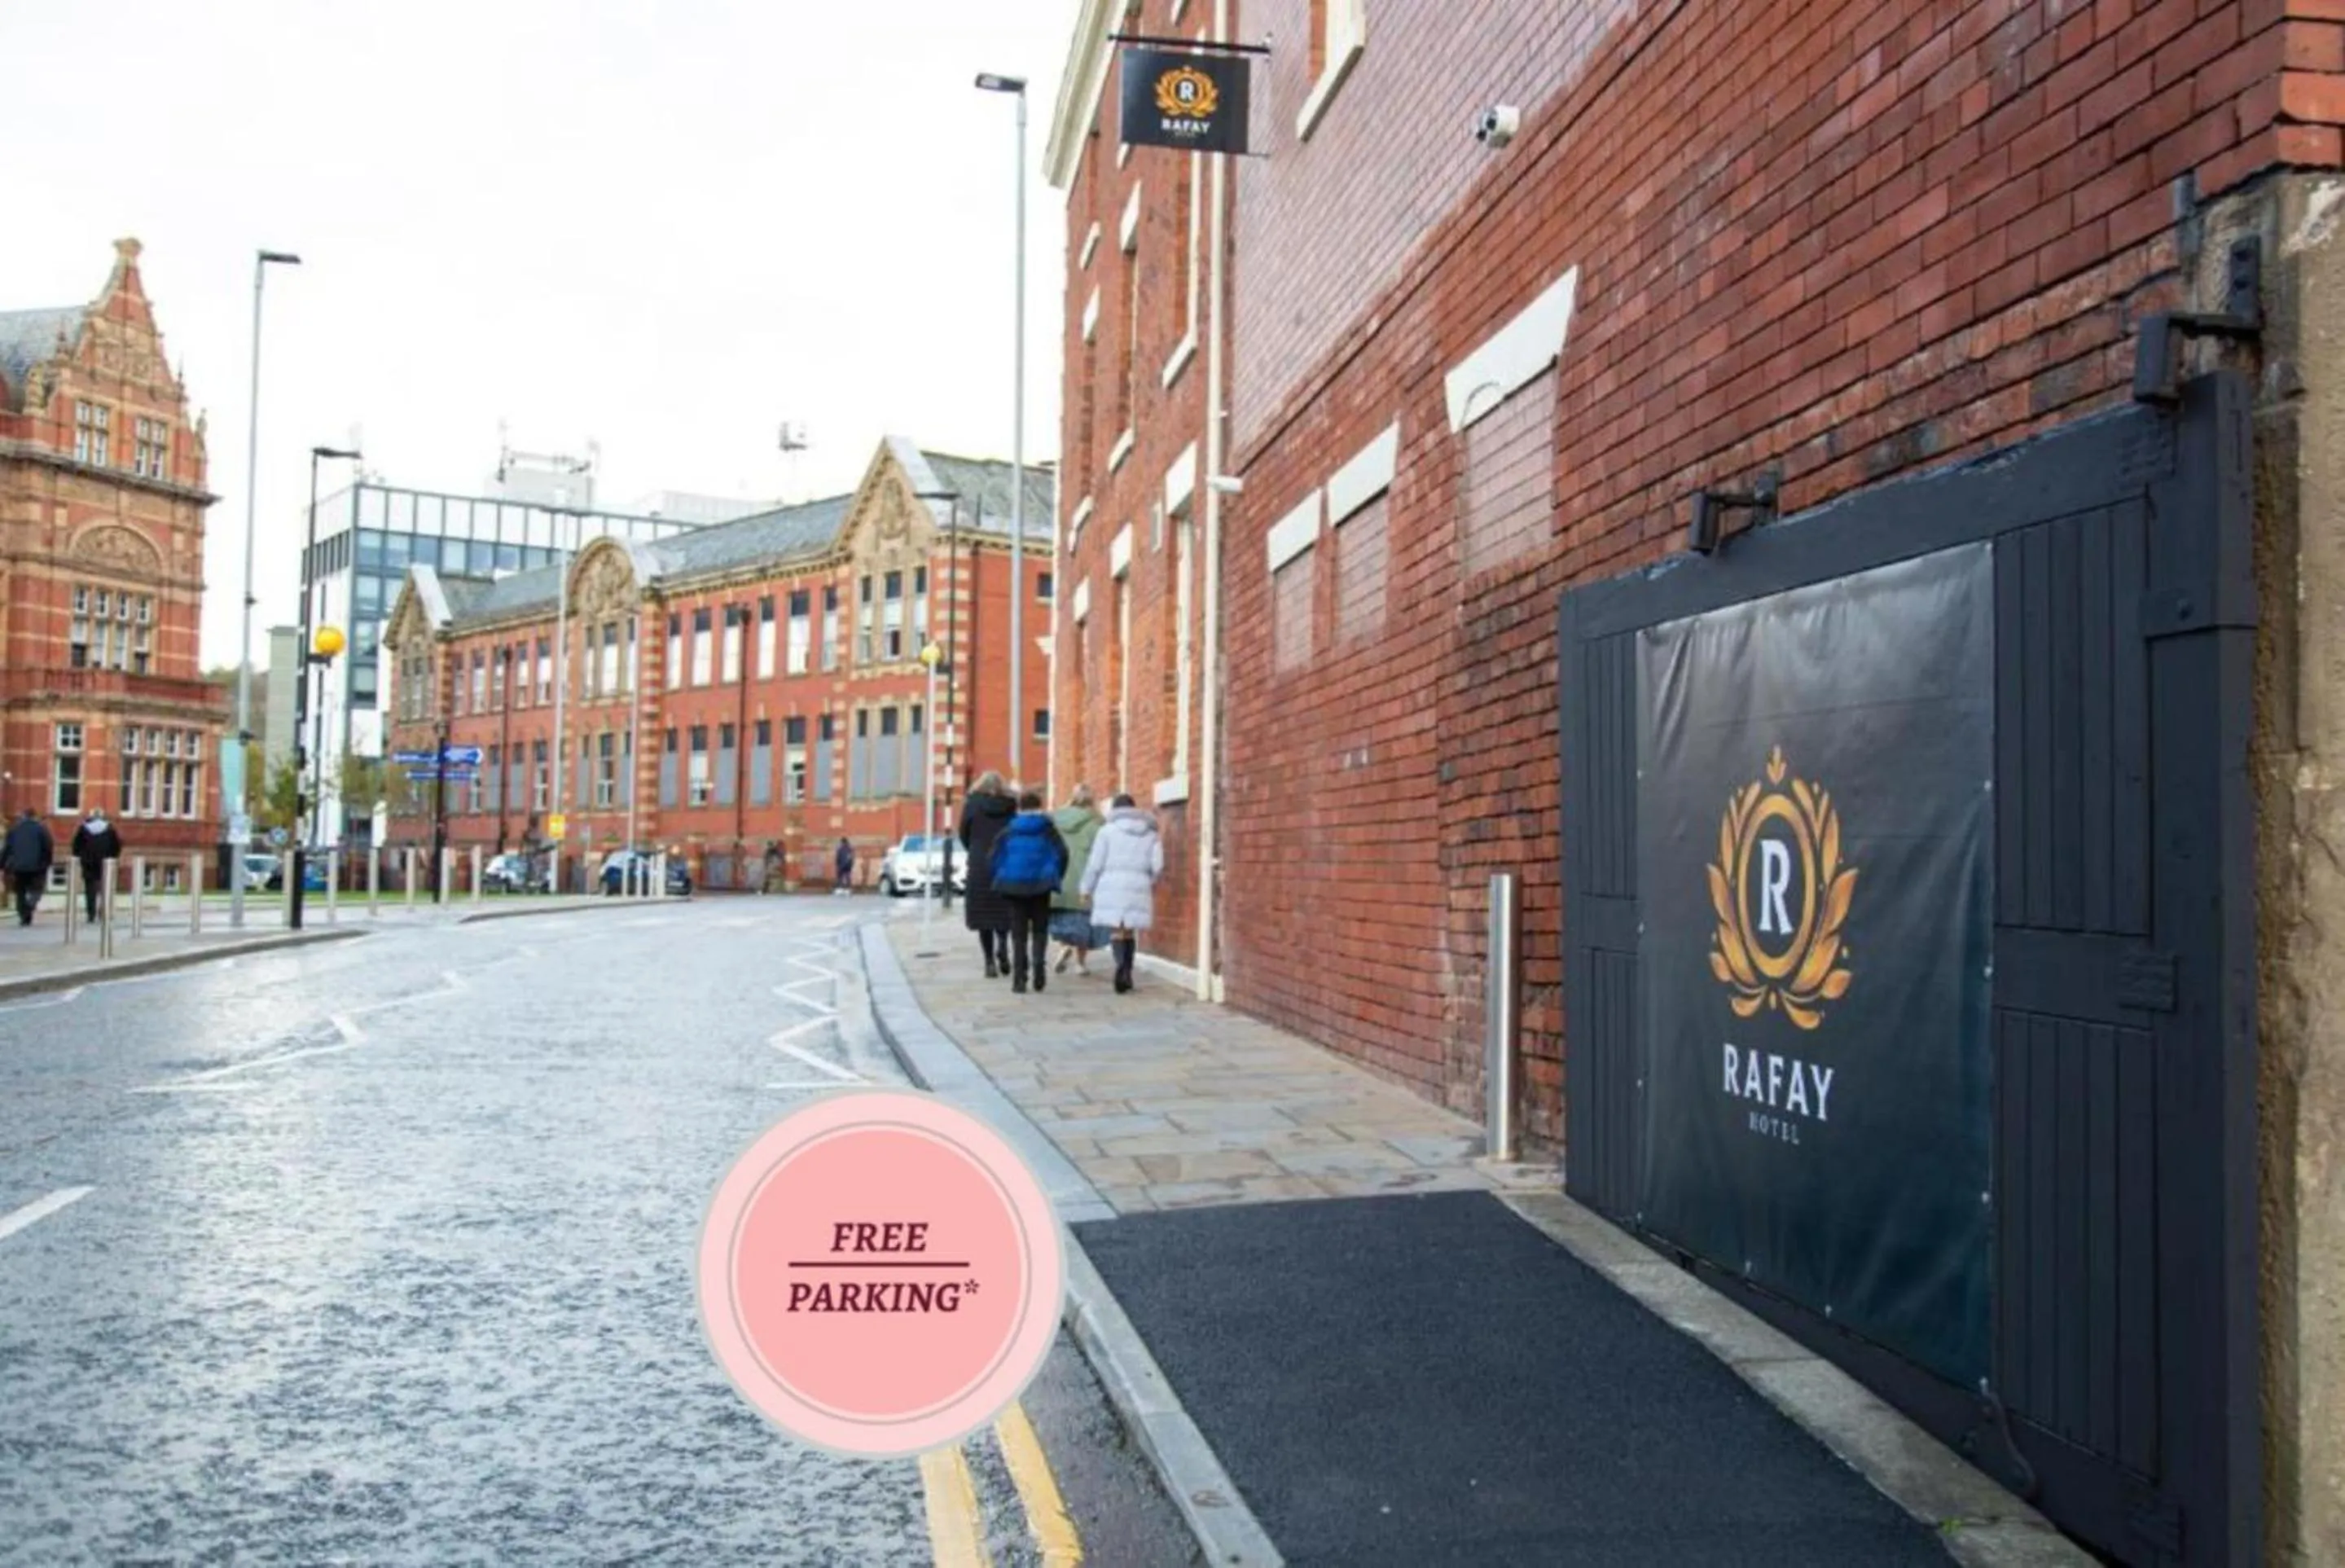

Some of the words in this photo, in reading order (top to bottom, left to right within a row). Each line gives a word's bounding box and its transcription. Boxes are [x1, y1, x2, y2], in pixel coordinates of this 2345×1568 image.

[1179, 81, 1194, 102] R
[1161, 118, 1210, 134] RAFAY
[1759, 838, 1794, 935] R
[1722, 1043, 1834, 1121] RAFAY
[1749, 1110, 1800, 1144] HOTEL
